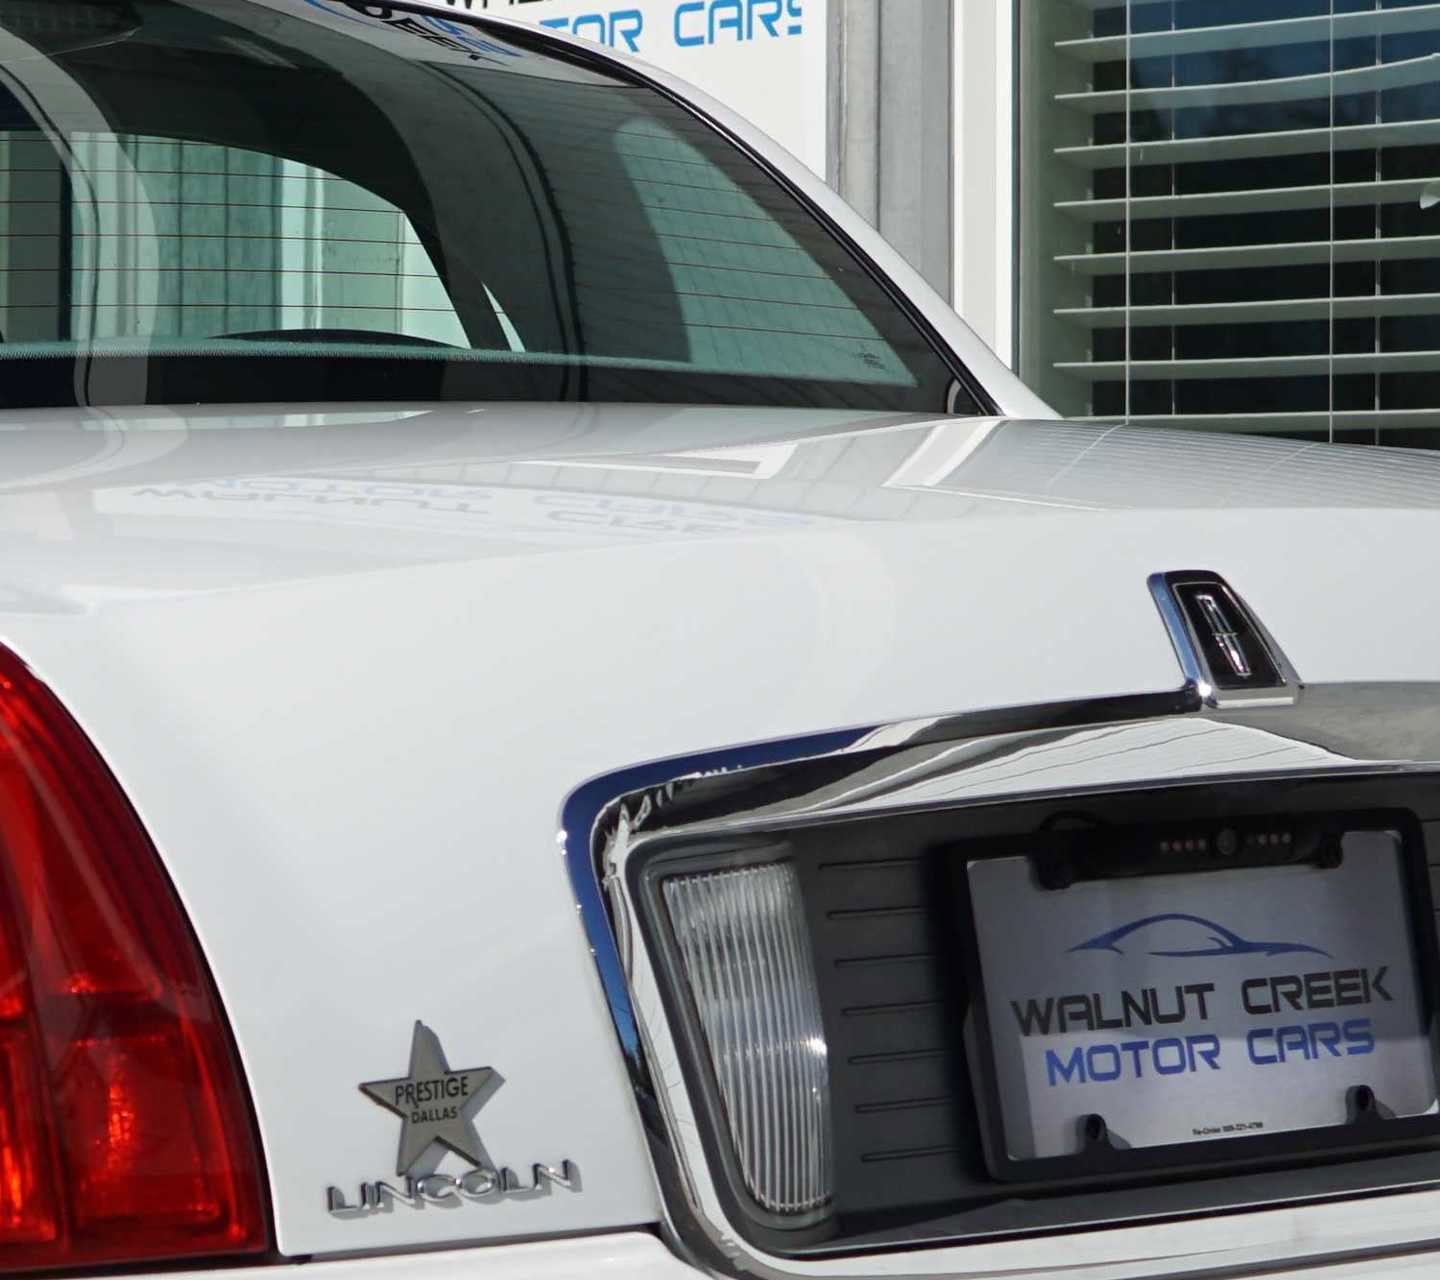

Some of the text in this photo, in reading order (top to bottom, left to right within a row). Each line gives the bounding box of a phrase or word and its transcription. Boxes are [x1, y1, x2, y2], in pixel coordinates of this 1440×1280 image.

[1009, 965, 1394, 1037] WALNUT CREEK
[1044, 1018, 1376, 1087] MOTOR CARS
[394, 1075, 469, 1124] PRESTIGE DALLAS
[325, 1158, 581, 1214] LINCOLN
